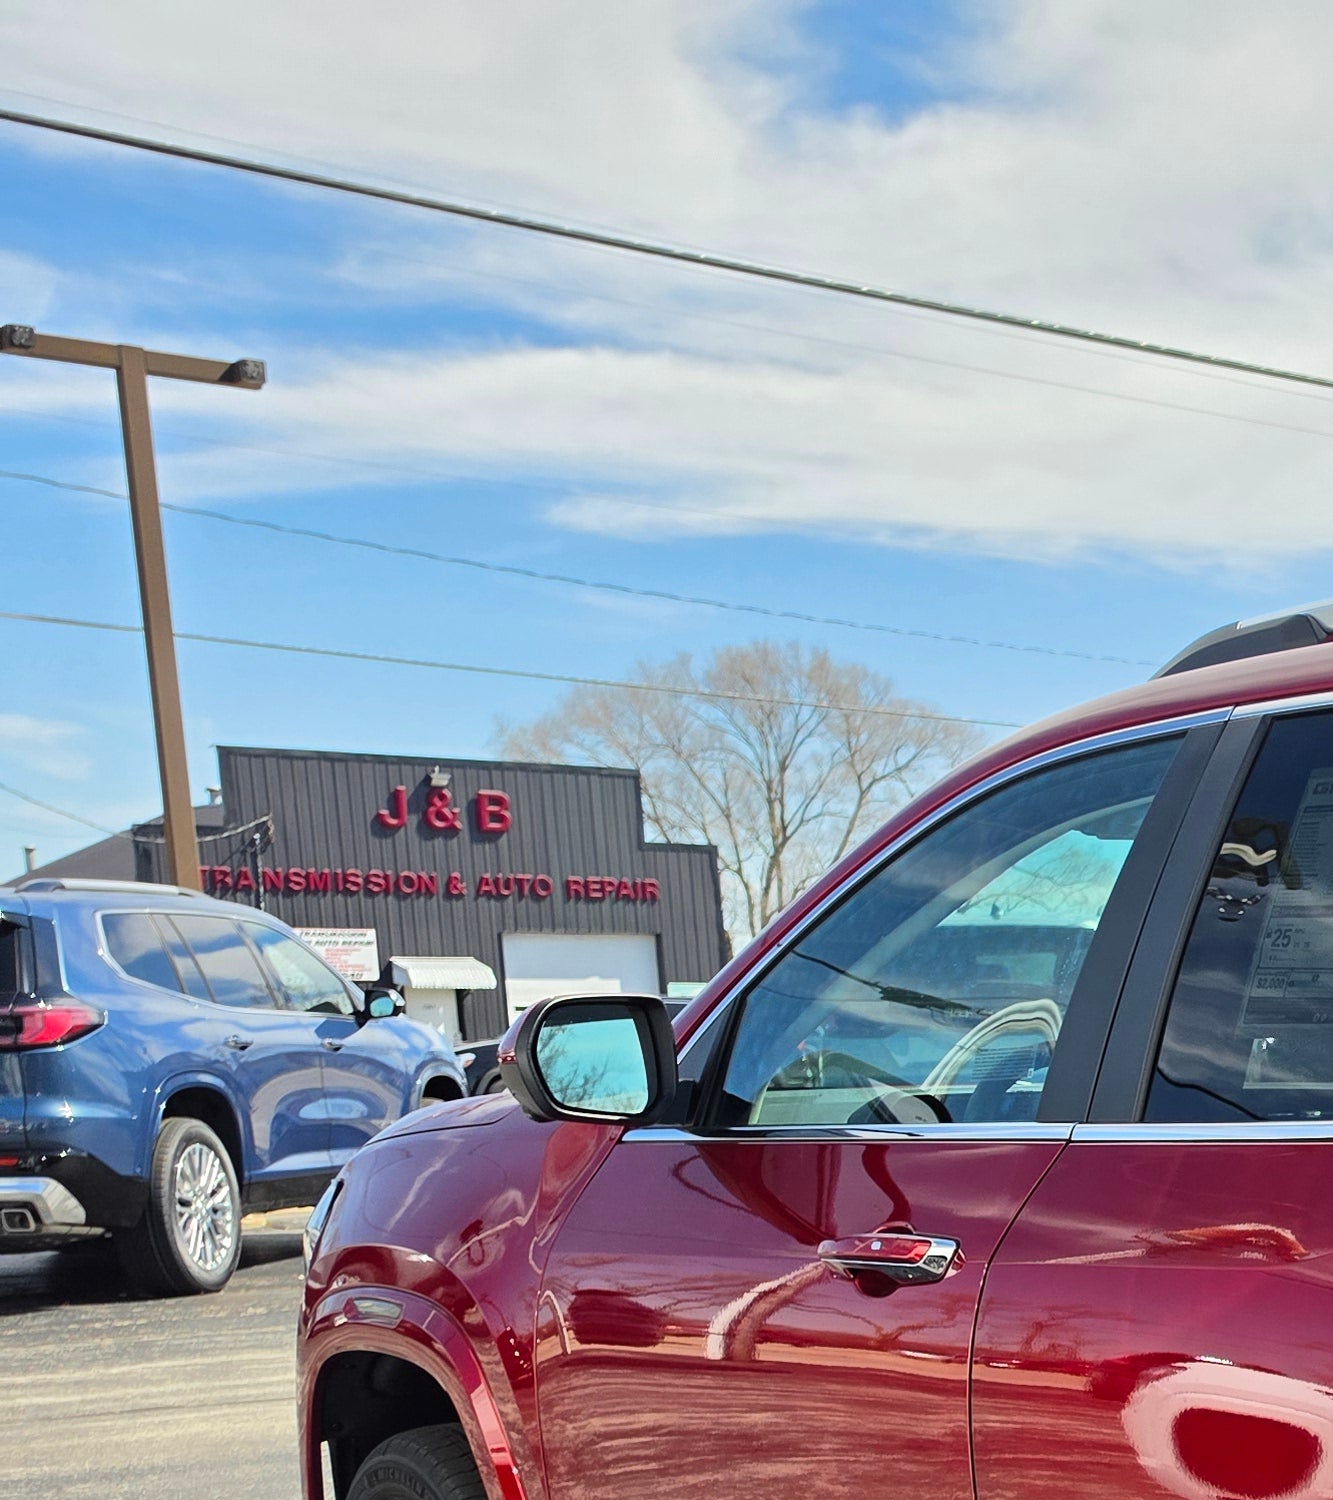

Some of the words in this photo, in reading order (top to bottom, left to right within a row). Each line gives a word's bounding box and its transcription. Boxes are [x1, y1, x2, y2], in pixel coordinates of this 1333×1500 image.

[378, 785, 408, 829] J
[425, 788, 463, 831] &
[475, 789, 512, 833] B
[199, 865, 438, 896] TRANSMISSION
[449, 871, 467, 896] &
[478, 872, 554, 897] AUTO
[566, 875, 660, 902] REPAIR
